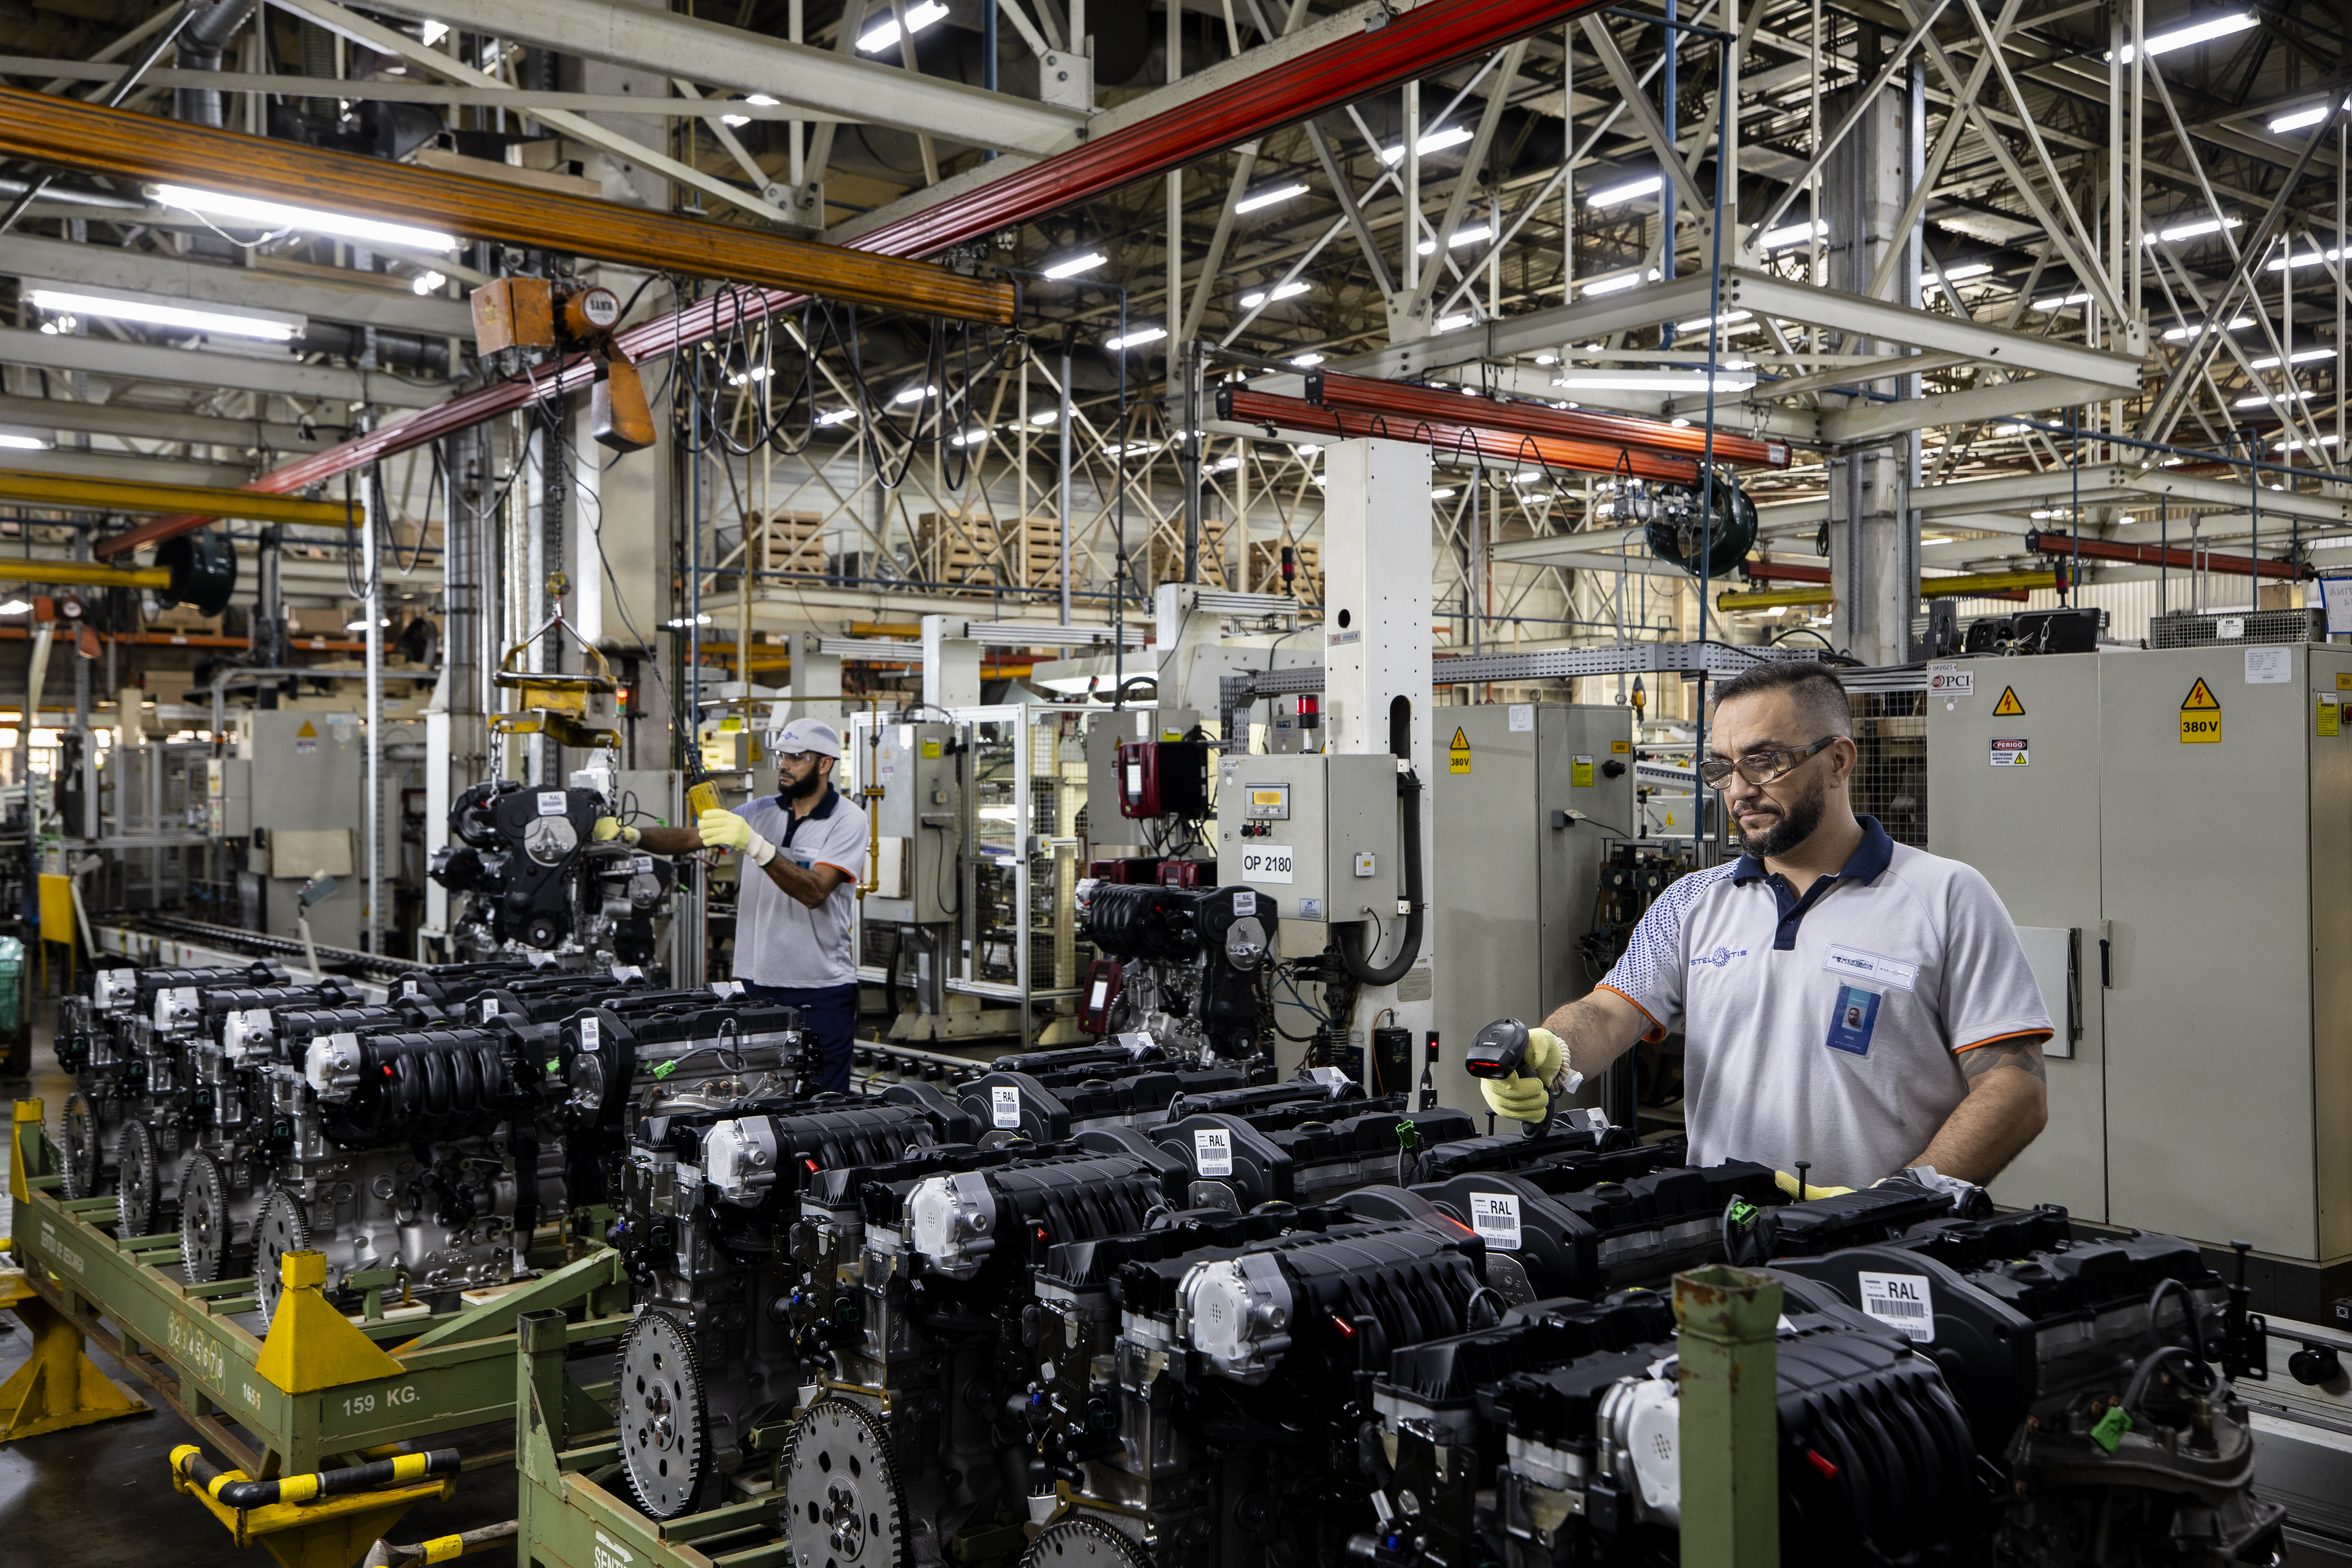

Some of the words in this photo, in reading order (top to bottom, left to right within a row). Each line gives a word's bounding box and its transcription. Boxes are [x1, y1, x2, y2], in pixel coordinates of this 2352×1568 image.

[1945, 675, 1970, 687] PCI
[1244, 855, 1261, 870] OP
[1265, 857, 1292, 872] 2180
[1691, 949, 1747, 966] STELLANTIS
[1003, 1092, 1015, 1102] RAL
[1209, 1135, 1225, 1147] RAL
[1490, 1200, 1512, 1215] RAL
[1887, 1281, 1920, 1300] RAL
[243, 1382, 261, 1410] 1655
[343, 1394, 376, 1416] 159
[387, 1385, 421, 1407] KG.
